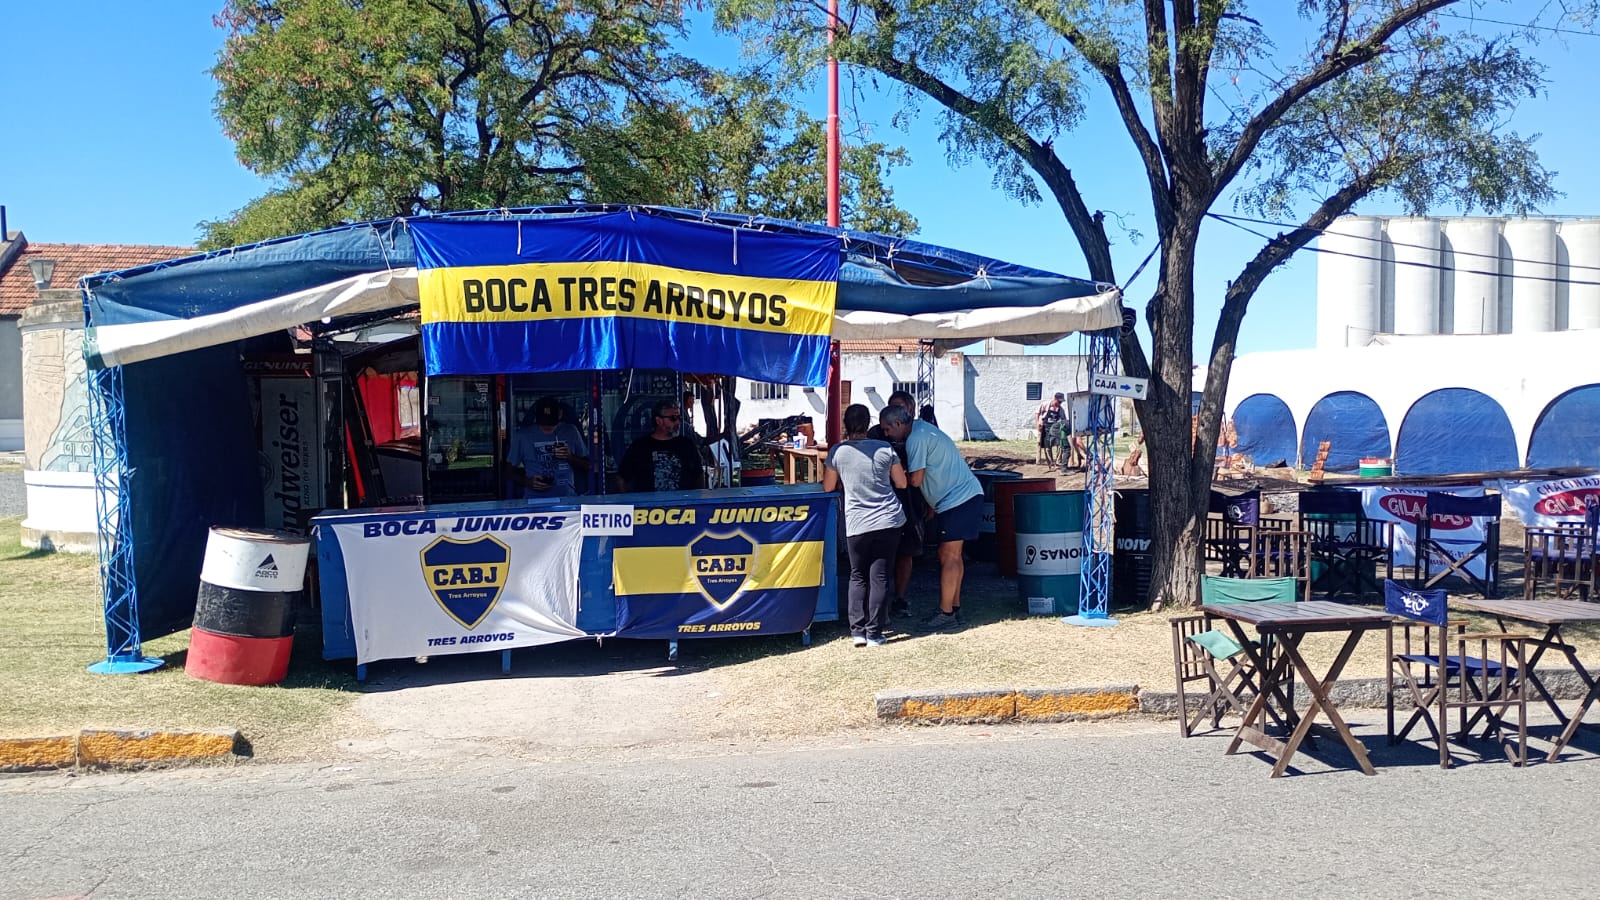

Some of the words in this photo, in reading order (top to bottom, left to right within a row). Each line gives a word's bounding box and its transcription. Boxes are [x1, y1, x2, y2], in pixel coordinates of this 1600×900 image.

[463, 278, 552, 313] BOCA
[558, 277, 637, 313] TRES
[643, 279, 787, 327] ARROYOS
[1095, 379, 1117, 390] CAJA
[272, 393, 301, 534] udweiser
[583, 513, 632, 529] RETIRO
[633, 508, 696, 525] BOCA
[708, 505, 810, 524] JUNIORS
[364, 519, 437, 538] BOCA
[451, 516, 567, 533] JUNIORS
[696, 557, 746, 573] CABJ
[433, 566, 498, 586] CABJ
[678, 625, 705, 633] TRES
[427, 637, 457, 646] TRES
